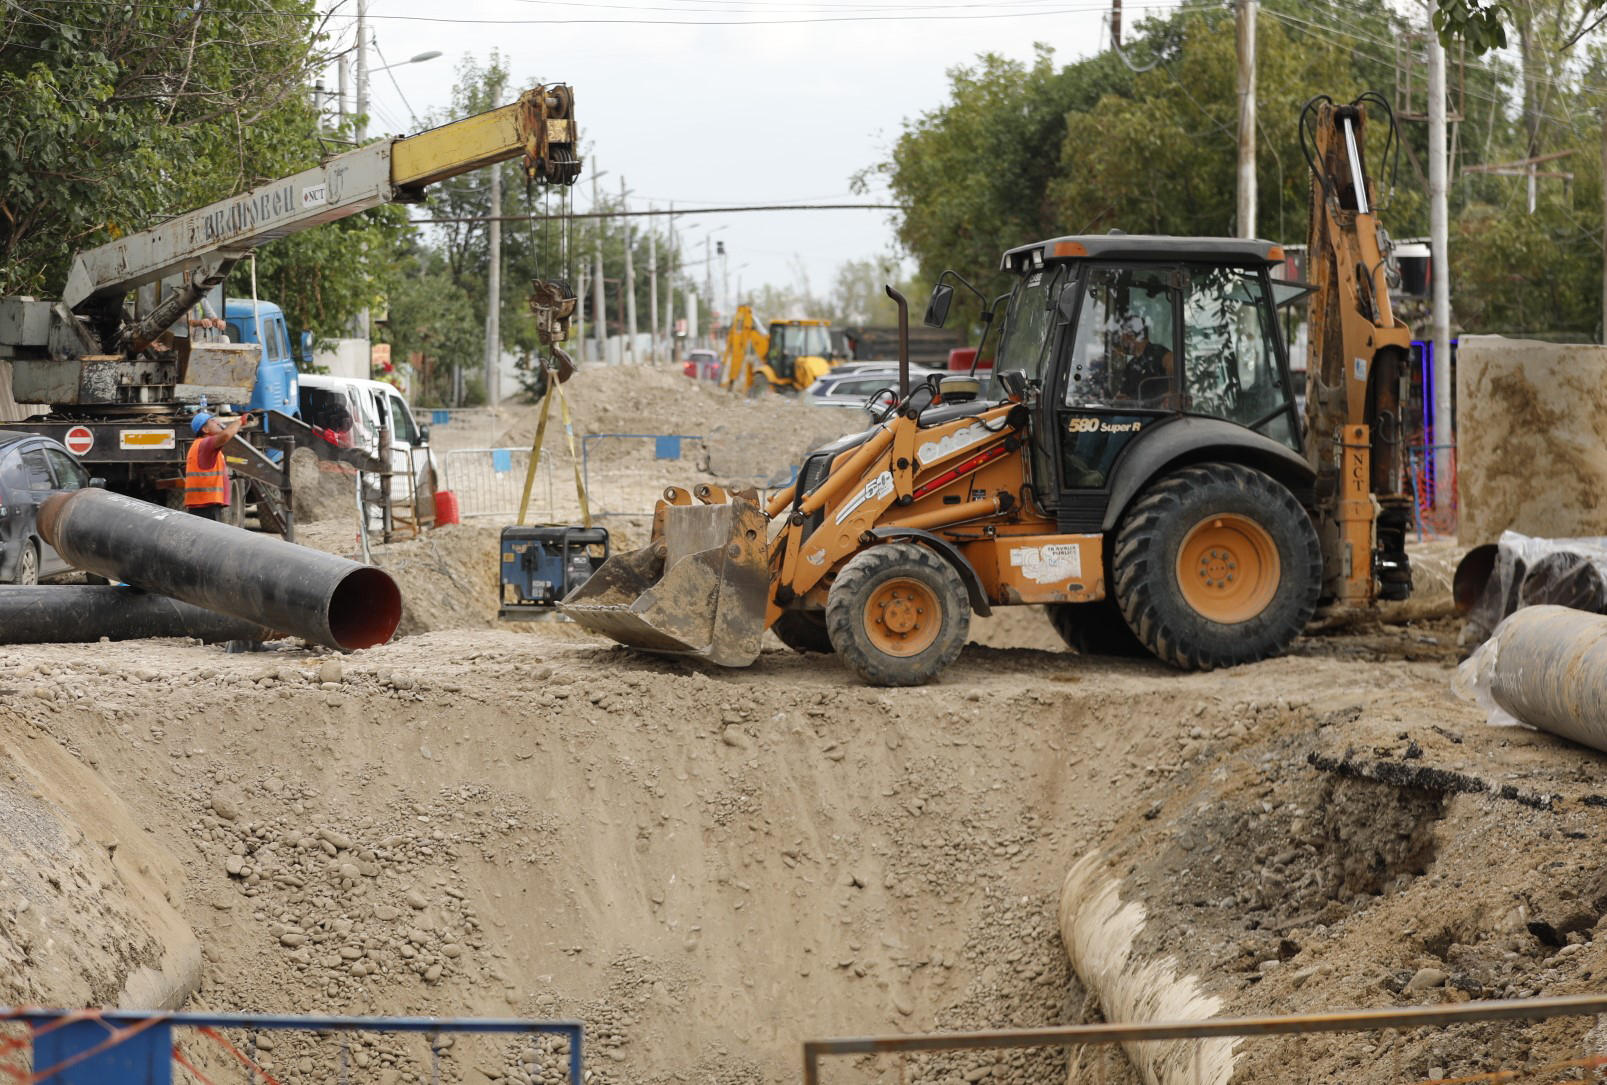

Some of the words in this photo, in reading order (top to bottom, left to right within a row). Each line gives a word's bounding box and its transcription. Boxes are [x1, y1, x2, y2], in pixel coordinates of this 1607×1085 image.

[308, 188, 325, 202] NCT
[1068, 417, 1100, 433] 580
[1100, 422, 1132, 434] Super
[1131, 421, 1142, 432] R
[1352, 453, 1364, 492] NCT
